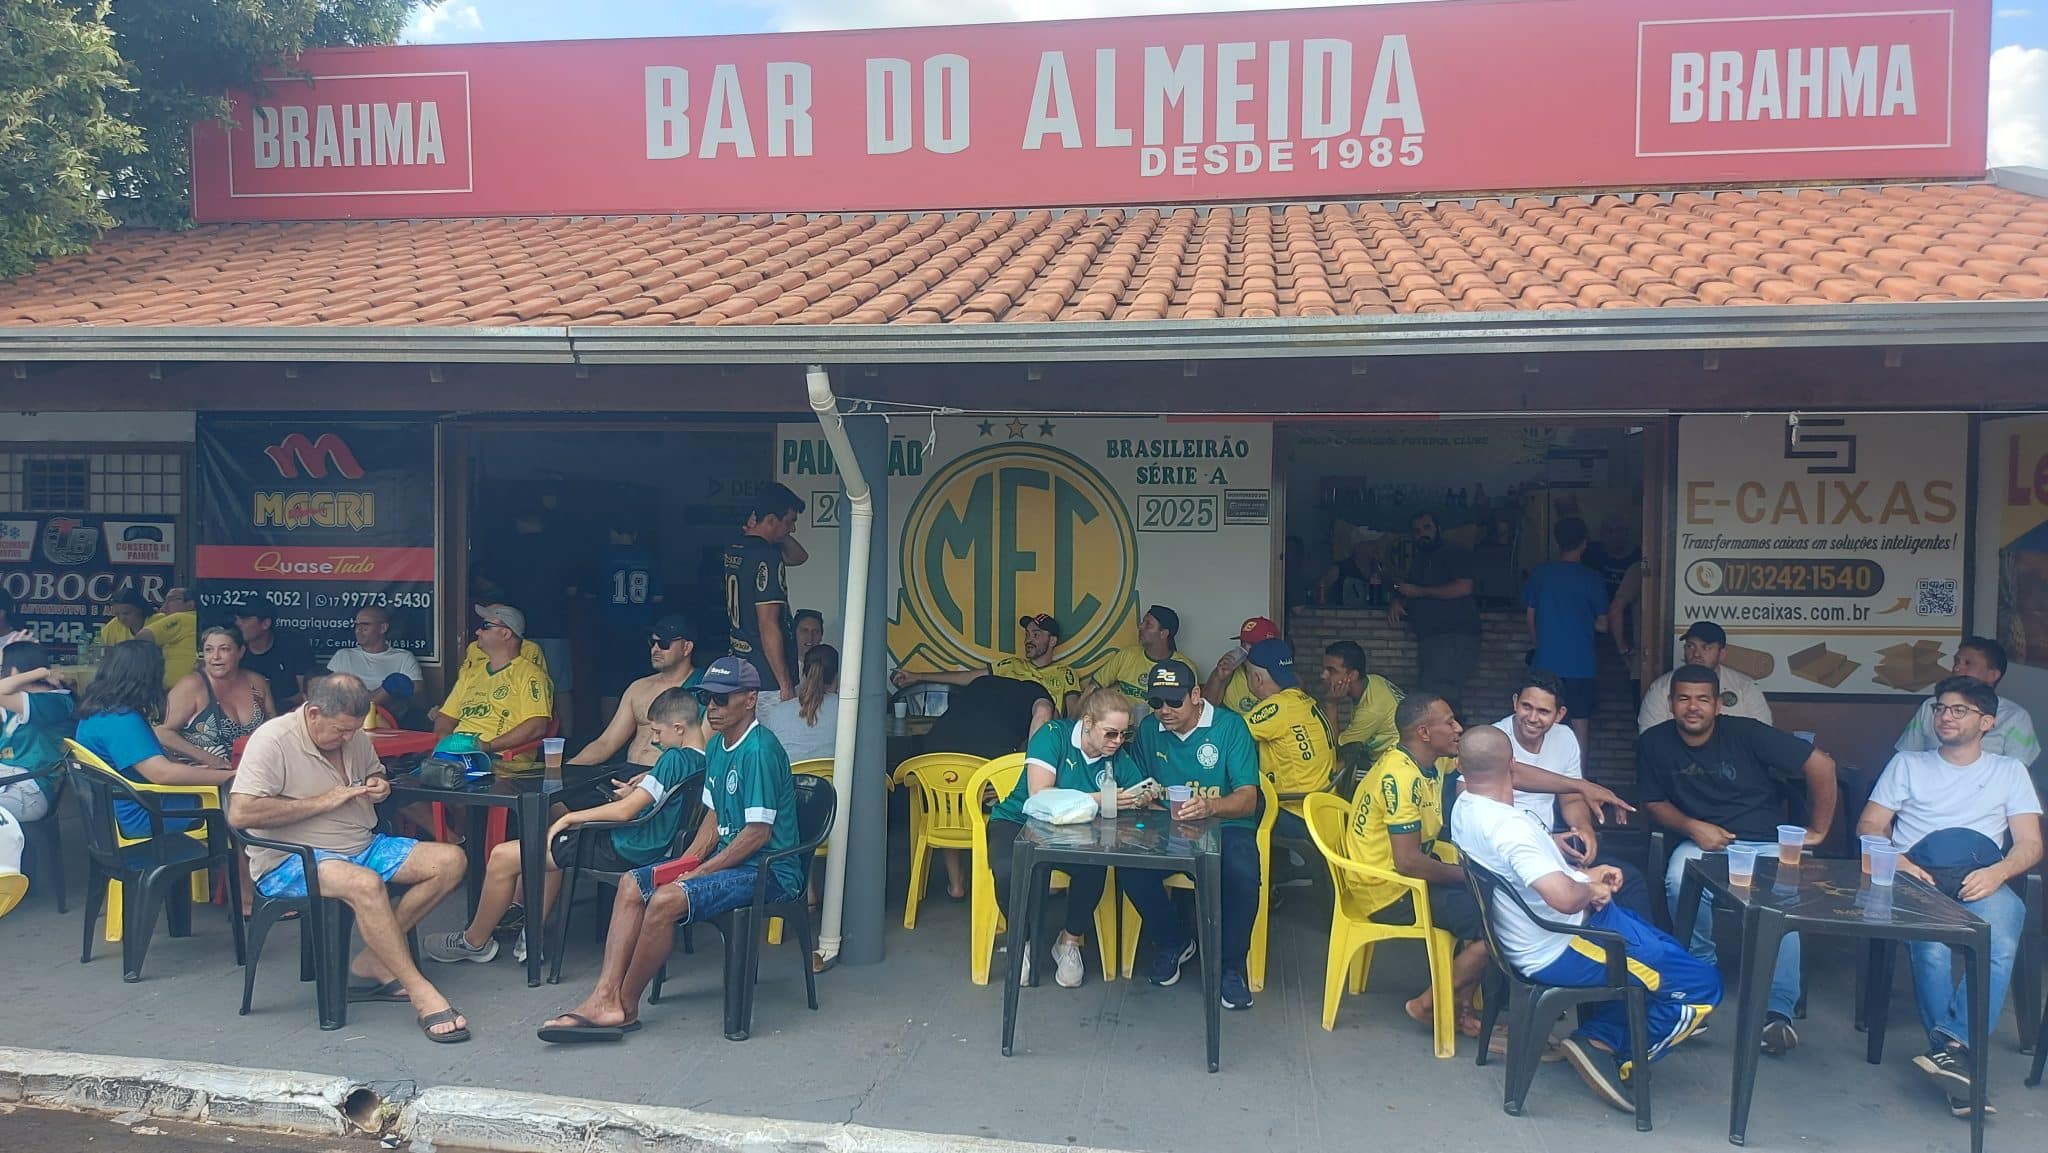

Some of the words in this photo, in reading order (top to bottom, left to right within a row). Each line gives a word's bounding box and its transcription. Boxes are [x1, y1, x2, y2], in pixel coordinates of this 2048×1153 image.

[645, 61, 813, 160] BAR
[866, 53, 970, 155] DO
[1022, 34, 1425, 150] ALMEIDA
[1669, 44, 1917, 123] BRAHMA
[253, 101, 446, 169] BRAHMA
[1140, 141, 1294, 177] DESDE
[1310, 136, 1425, 170] 1985
[783, 435, 923, 476] PAUÃO
[1106, 435, 1249, 458] BRASILEIRÃO
[1137, 463, 1197, 485] SÉRIE
[1208, 467, 1229, 485] A
[1143, 498, 1213, 527] 2025
[1686, 480, 1957, 525] E-CAIXAS
[1682, 533, 1771, 551] Transformamos
[1773, 536, 1808, 551] caixas
[1811, 537, 1827, 550] em
[1830, 535, 1878, 553] soluções
[1880, 533, 1958, 554] inteligentes!
[0, 572, 165, 603] OBOCAR
[328, 596, 340, 607] 17
[341, 592, 431, 609] 99773-5430
[612, 570, 649, 604] 18
[1684, 602, 1870, 621] www.ecaixas.com.br
